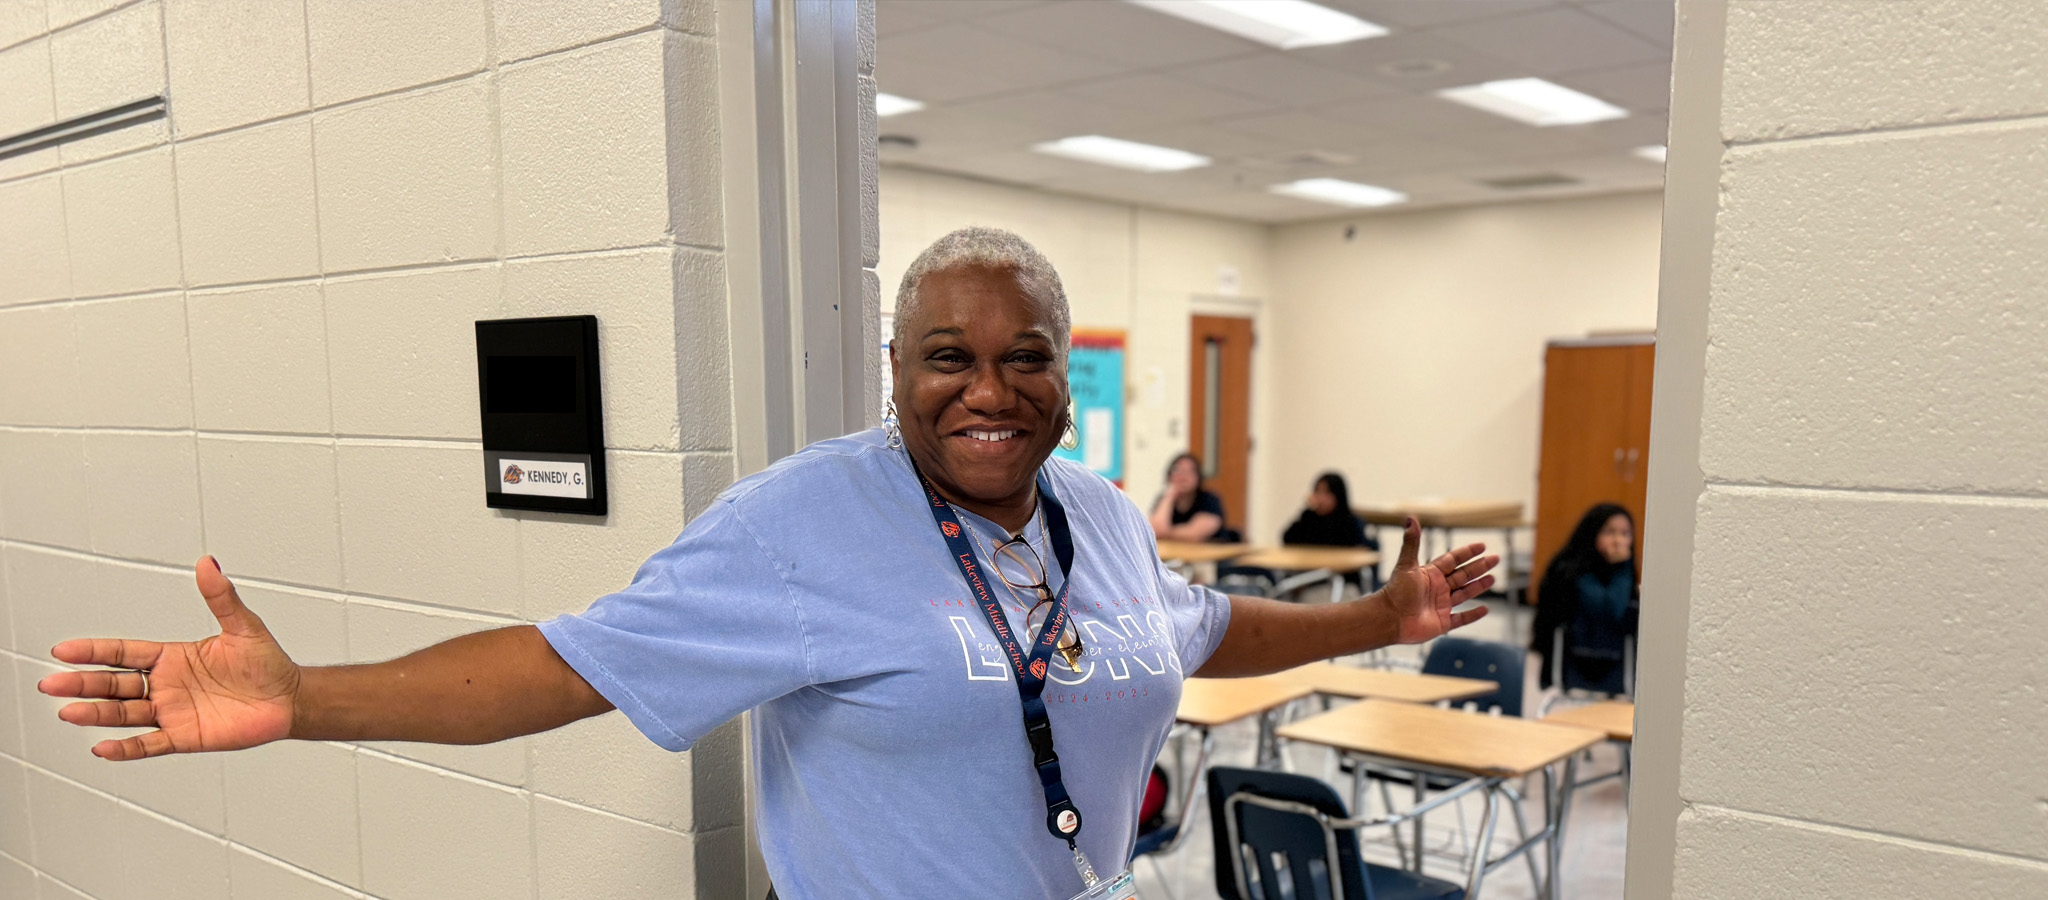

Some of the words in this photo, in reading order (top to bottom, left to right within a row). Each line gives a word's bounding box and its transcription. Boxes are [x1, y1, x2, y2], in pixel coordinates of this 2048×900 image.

[527, 470, 571, 485] KENNEDY,
[573, 472, 584, 485] G.
[959, 553, 990, 601] Lakeview
[984, 603, 1009, 639] Middle
[1005, 641, 1027, 679] Schoo
[1042, 607, 1066, 646] Lakeview
